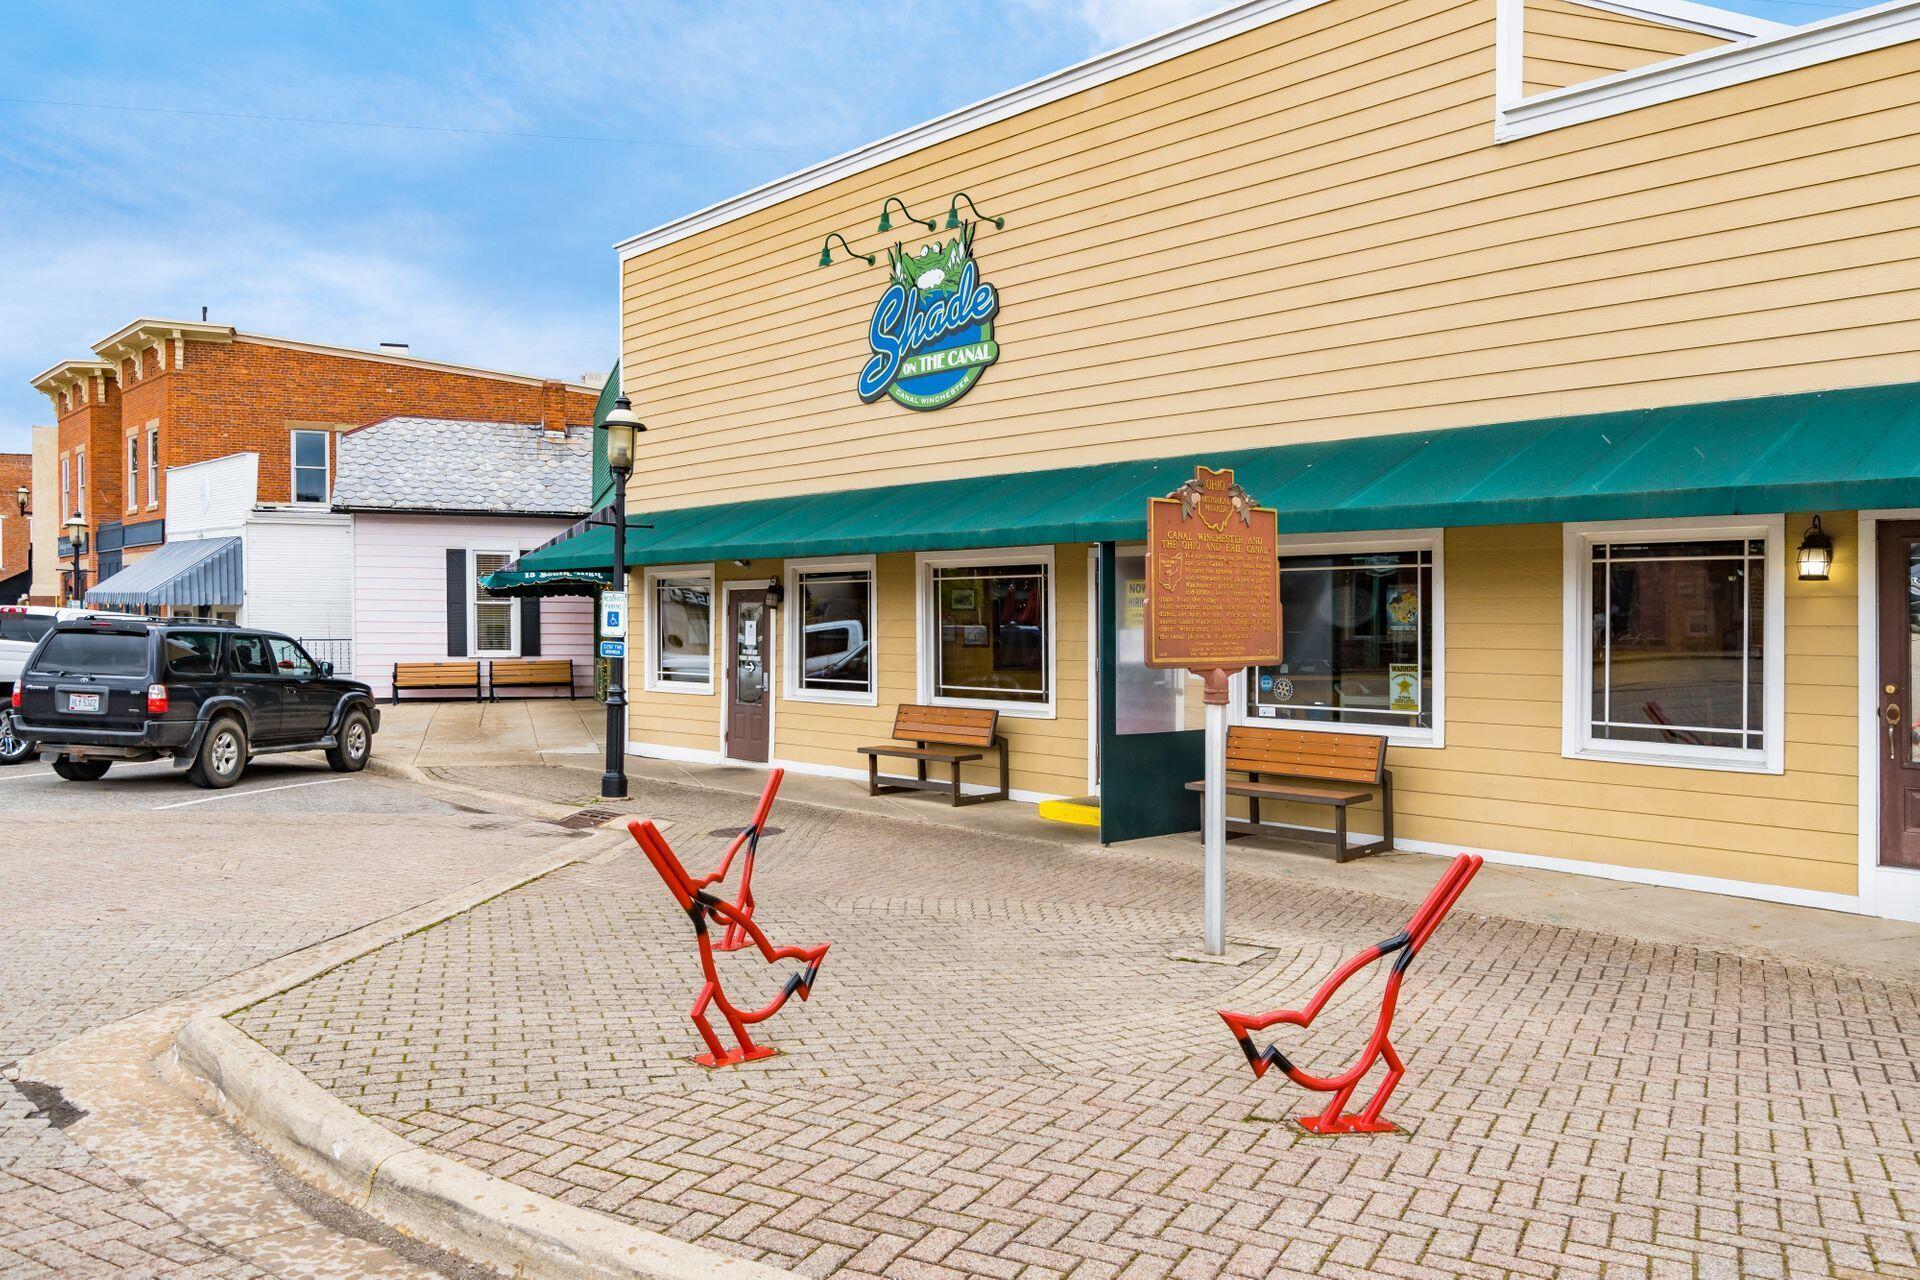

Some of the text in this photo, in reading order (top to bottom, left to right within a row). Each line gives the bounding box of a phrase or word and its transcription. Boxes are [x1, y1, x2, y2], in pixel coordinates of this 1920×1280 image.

[859, 261, 994, 397] Shade
[903, 344, 992, 375] ON THE CANAL
[896, 376, 970, 404] CANAL WINCHESTER
[1205, 479, 1226, 491] OHIO
[1161, 539, 1177, 549] THE
[1181, 541, 1201, 550] OHIO
[1205, 542, 1221, 552] AND
[1225, 543, 1243, 553] ERIE
[1167, 530, 1263, 545] CANAL WINCHESTER AND
